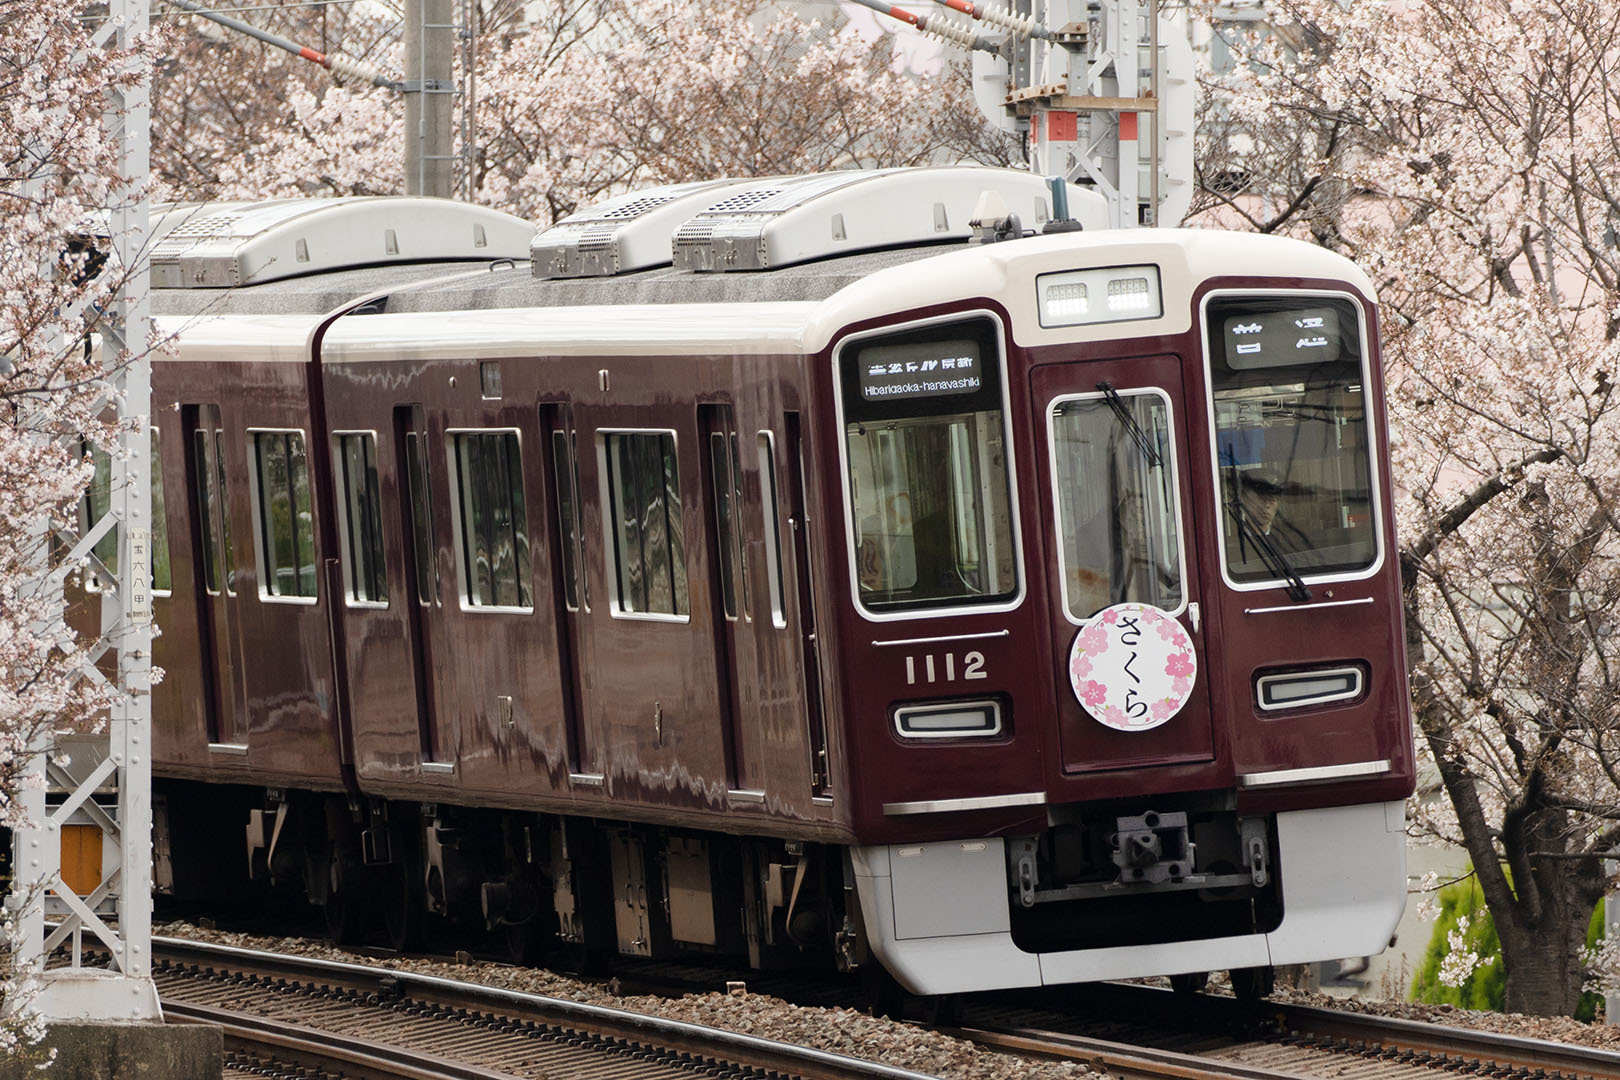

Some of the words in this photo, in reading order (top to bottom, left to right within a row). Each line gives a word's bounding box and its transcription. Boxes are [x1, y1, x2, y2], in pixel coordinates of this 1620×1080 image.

[906, 651, 987, 685] 1112
[1116, 616, 1148, 719] さくら
